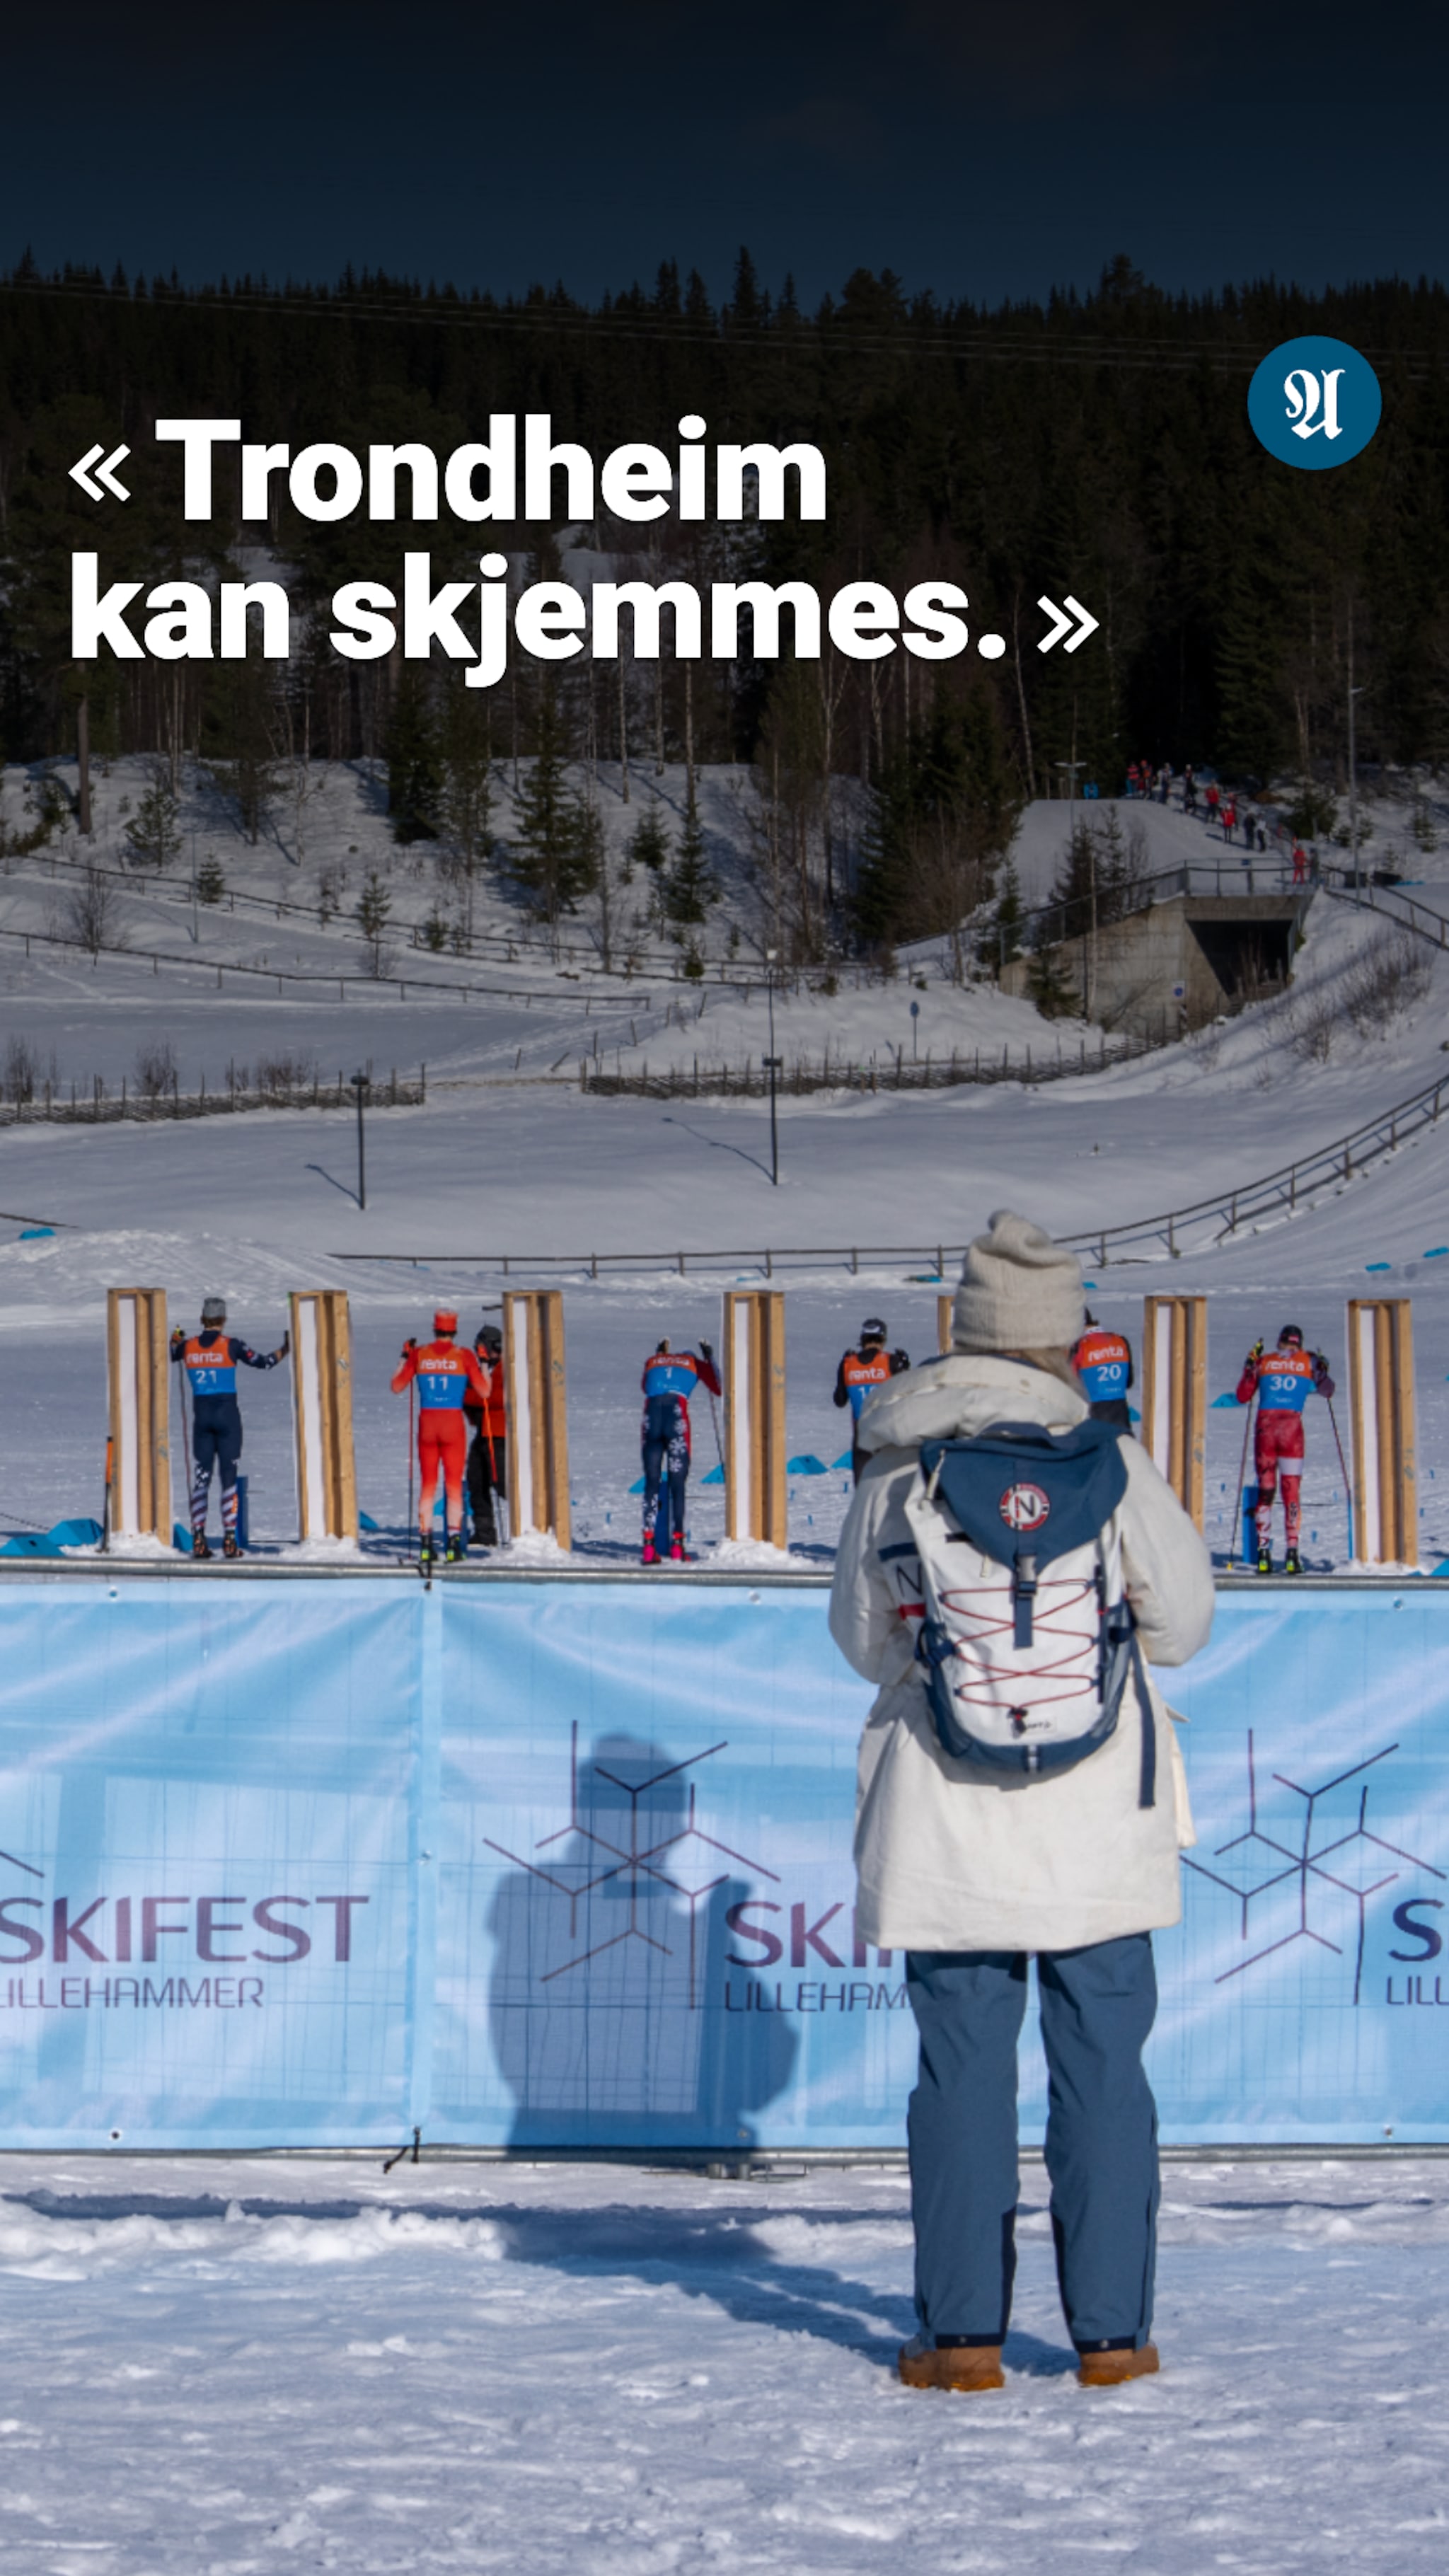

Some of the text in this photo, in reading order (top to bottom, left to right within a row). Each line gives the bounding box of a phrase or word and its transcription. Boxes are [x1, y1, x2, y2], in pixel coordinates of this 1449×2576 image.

[186, 1351, 224, 1364] renta
[1087, 1345, 1124, 1362] renta
[420, 1358, 458, 1370] renta
[1264, 1360, 1305, 1373] renta
[195, 1369, 218, 1384] 21
[664, 1365, 674, 1380] 1
[848, 1366, 887, 1381] renta
[1097, 1364, 1122, 1382] 20
[427, 1375, 449, 1391] 11
[1269, 1375, 1298, 1392] 30
[1014, 1494, 1035, 1519] N
[0, 1895, 371, 1964] SKIFEST
[724, 1900, 892, 1968] SKI
[1387, 1898, 1449, 1963] S
